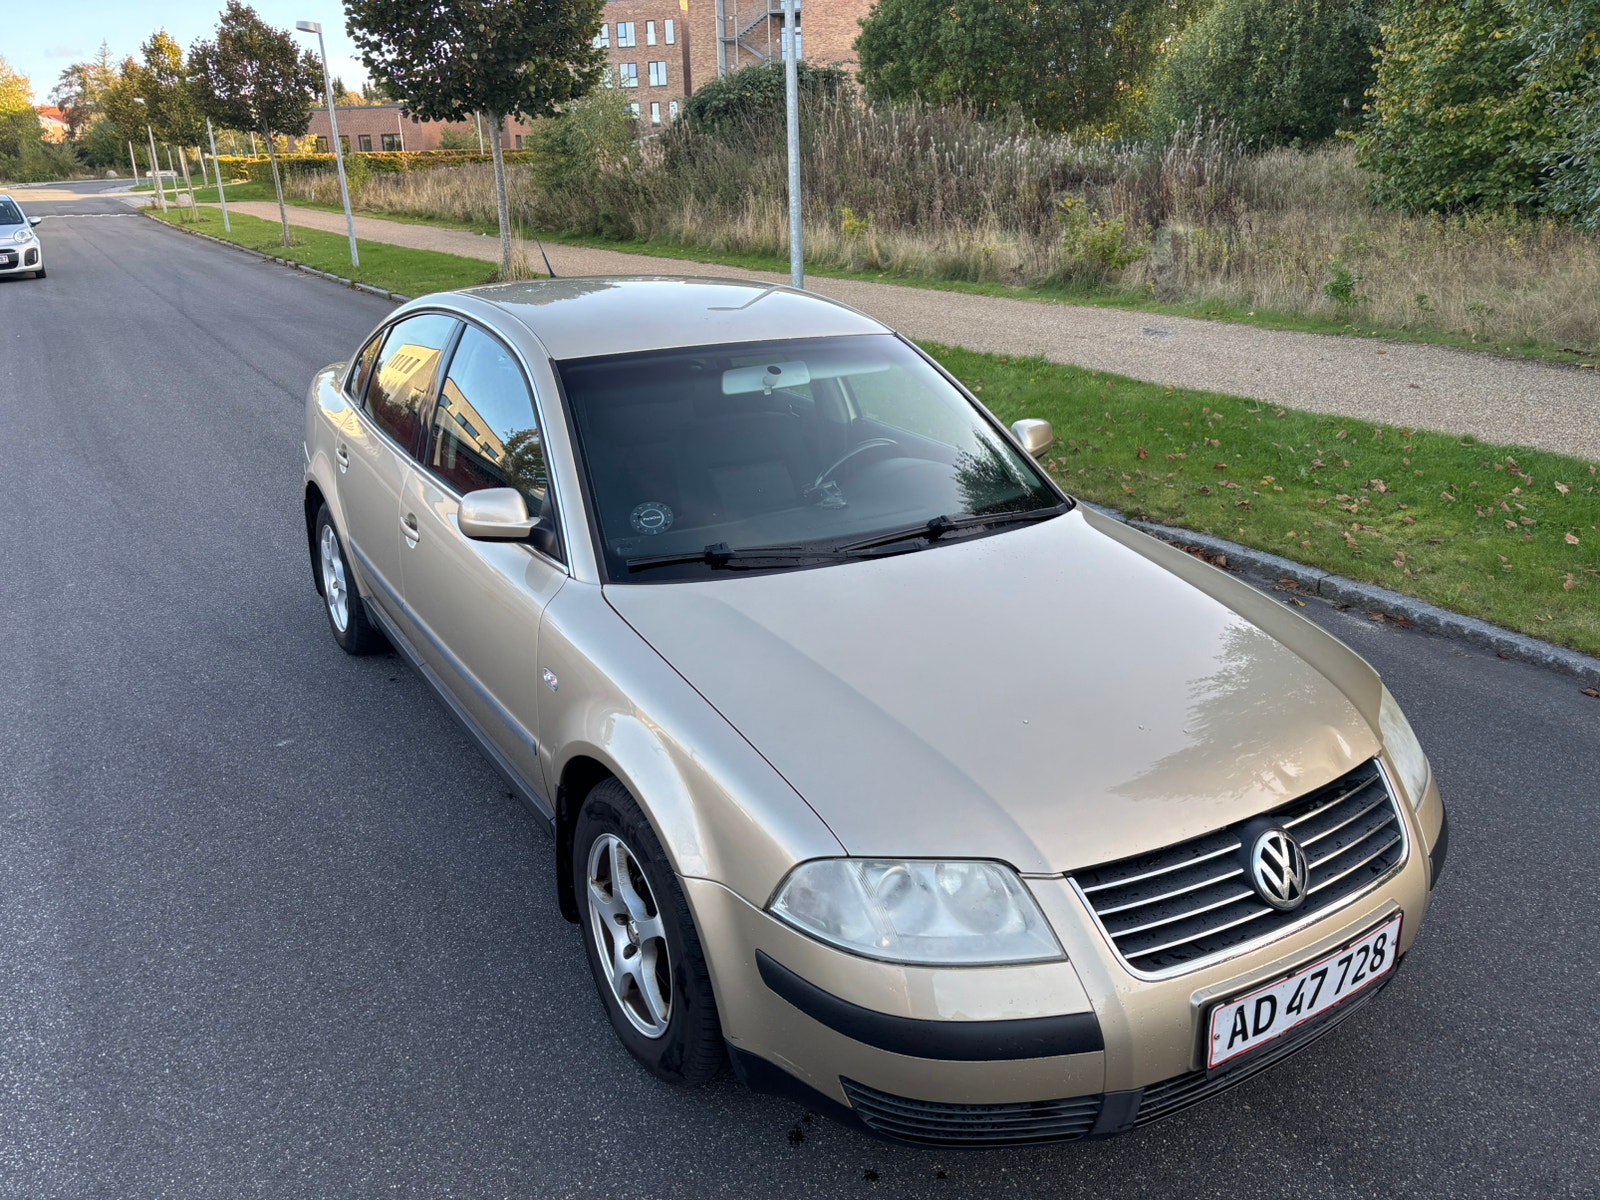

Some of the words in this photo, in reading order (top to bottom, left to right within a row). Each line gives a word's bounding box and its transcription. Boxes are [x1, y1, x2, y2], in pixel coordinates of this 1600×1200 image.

[1227, 994, 1278, 1050] AD
[1285, 967, 1329, 1016] 47
[1334, 932, 1388, 995] 728
